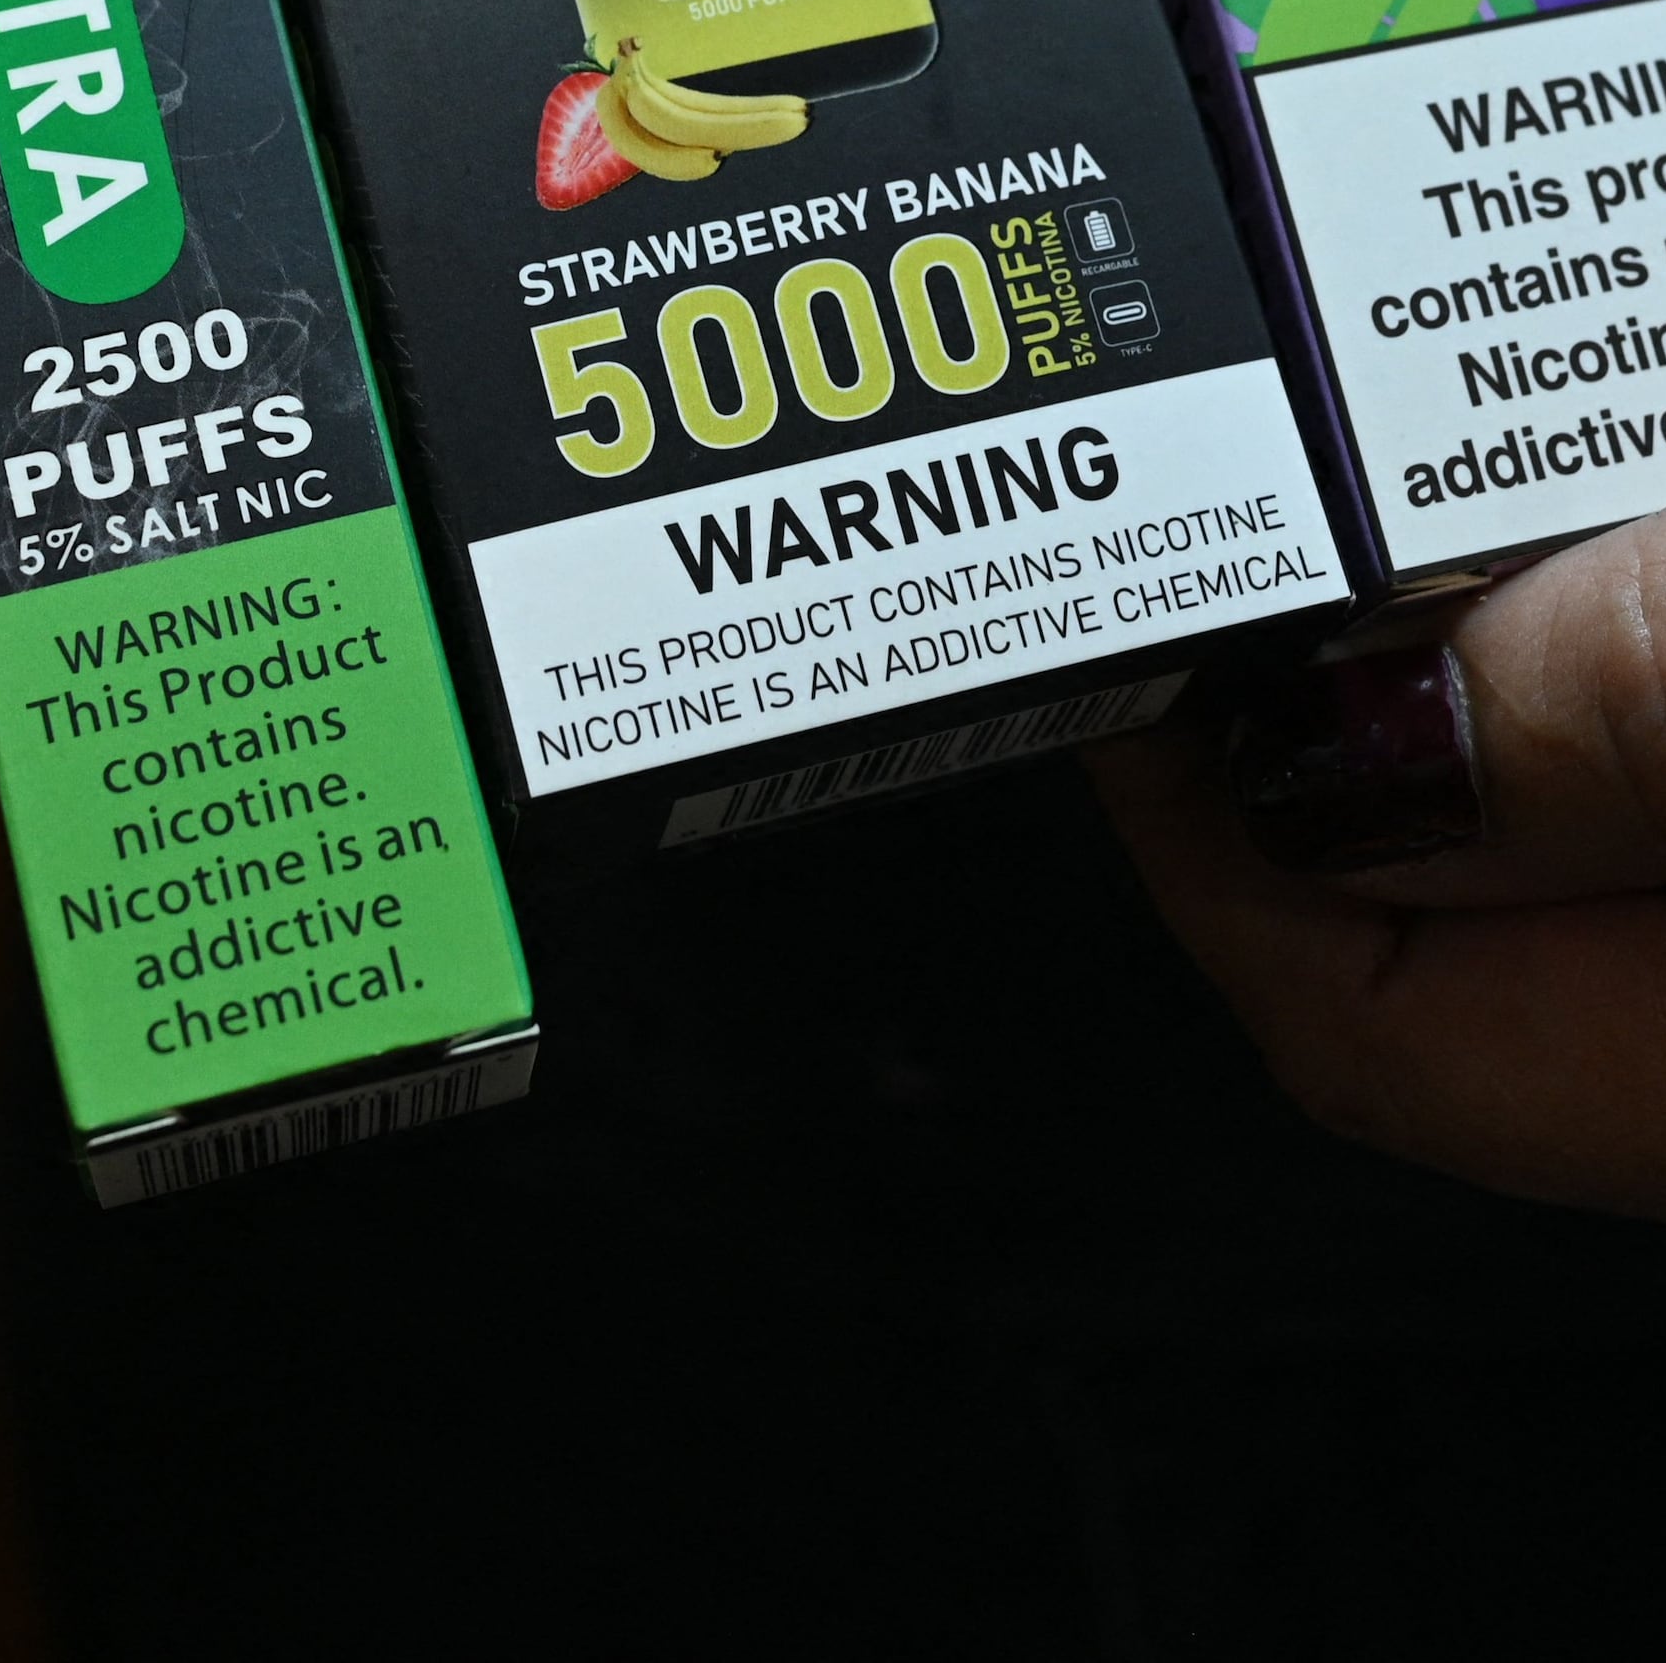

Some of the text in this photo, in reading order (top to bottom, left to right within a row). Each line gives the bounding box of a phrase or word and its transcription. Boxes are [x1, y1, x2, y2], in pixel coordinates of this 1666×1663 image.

[518, 141, 1106, 308] STRAWBERRY BANANA
[1422, 172, 1570, 239] This
[990, 216, 1072, 377] PUFFS
[1034, 210, 1097, 367] 5% NICOTINA
[1370, 243, 1650, 339] contains
[23, 308, 248, 413] 2500
[529, 232, 1011, 479] 5000
[1121, 344, 1153, 357] TYPE-C
[3, 394, 314, 518] PUFFS
[664, 426, 1122, 597] WARNING
[18, 469, 333, 576] 5% SALT NIC
[54, 577, 343, 676] WARNING:
[536, 545, 1328, 767] NICOTINE IS AN ADDICTIVE CHEMICAL
[543, 494, 1287, 703] THIS PRODUCT CONTAINS NICOTINE
[26, 626, 388, 745] This Product
[102, 706, 347, 795] contains
[112, 771, 367, 860] nicotine.
[59, 815, 445, 941] Nicotine is an
[135, 892, 403, 991] addictive
[145, 945, 425, 1056] chemical.
